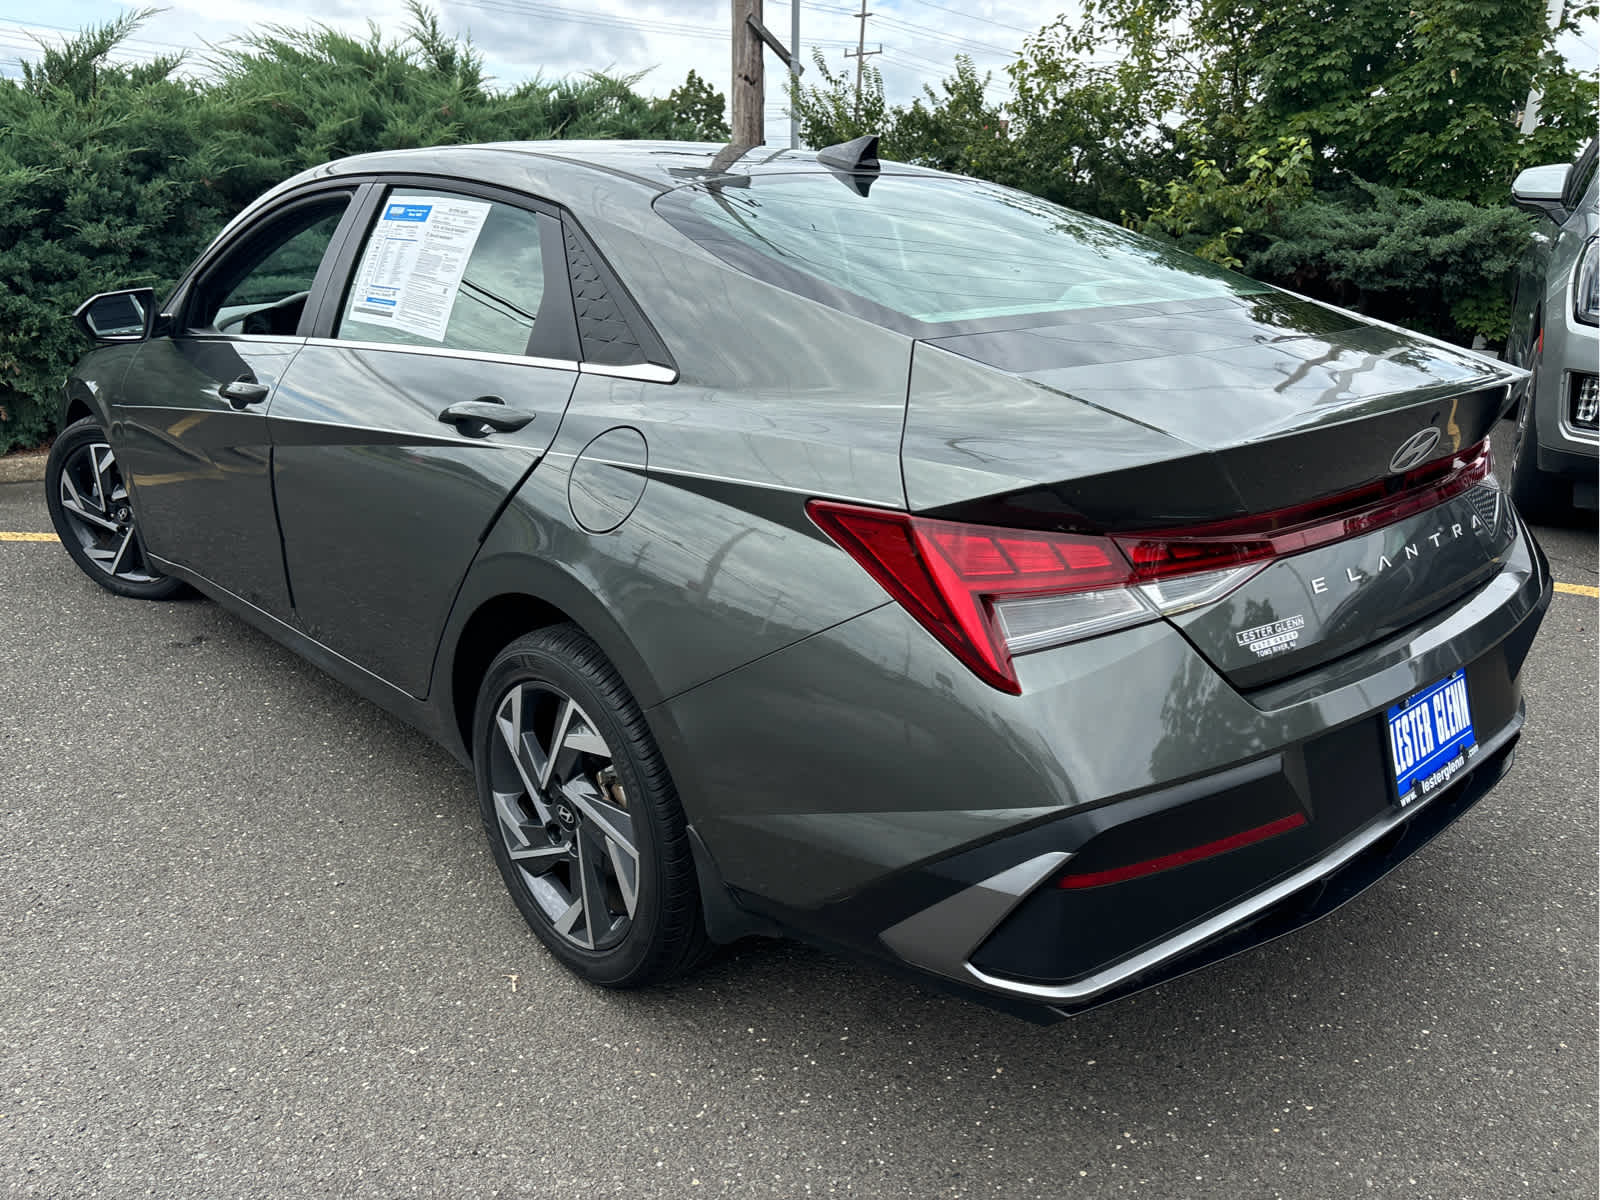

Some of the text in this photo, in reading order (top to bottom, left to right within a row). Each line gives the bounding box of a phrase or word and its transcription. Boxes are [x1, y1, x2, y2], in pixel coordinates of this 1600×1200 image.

[1311, 514, 1481, 595] ELANTRA
[1236, 617, 1304, 644] LESTER GLENN
[1389, 678, 1470, 776] LESTER GLENN
[1421, 755, 1464, 793] lesterglenn
